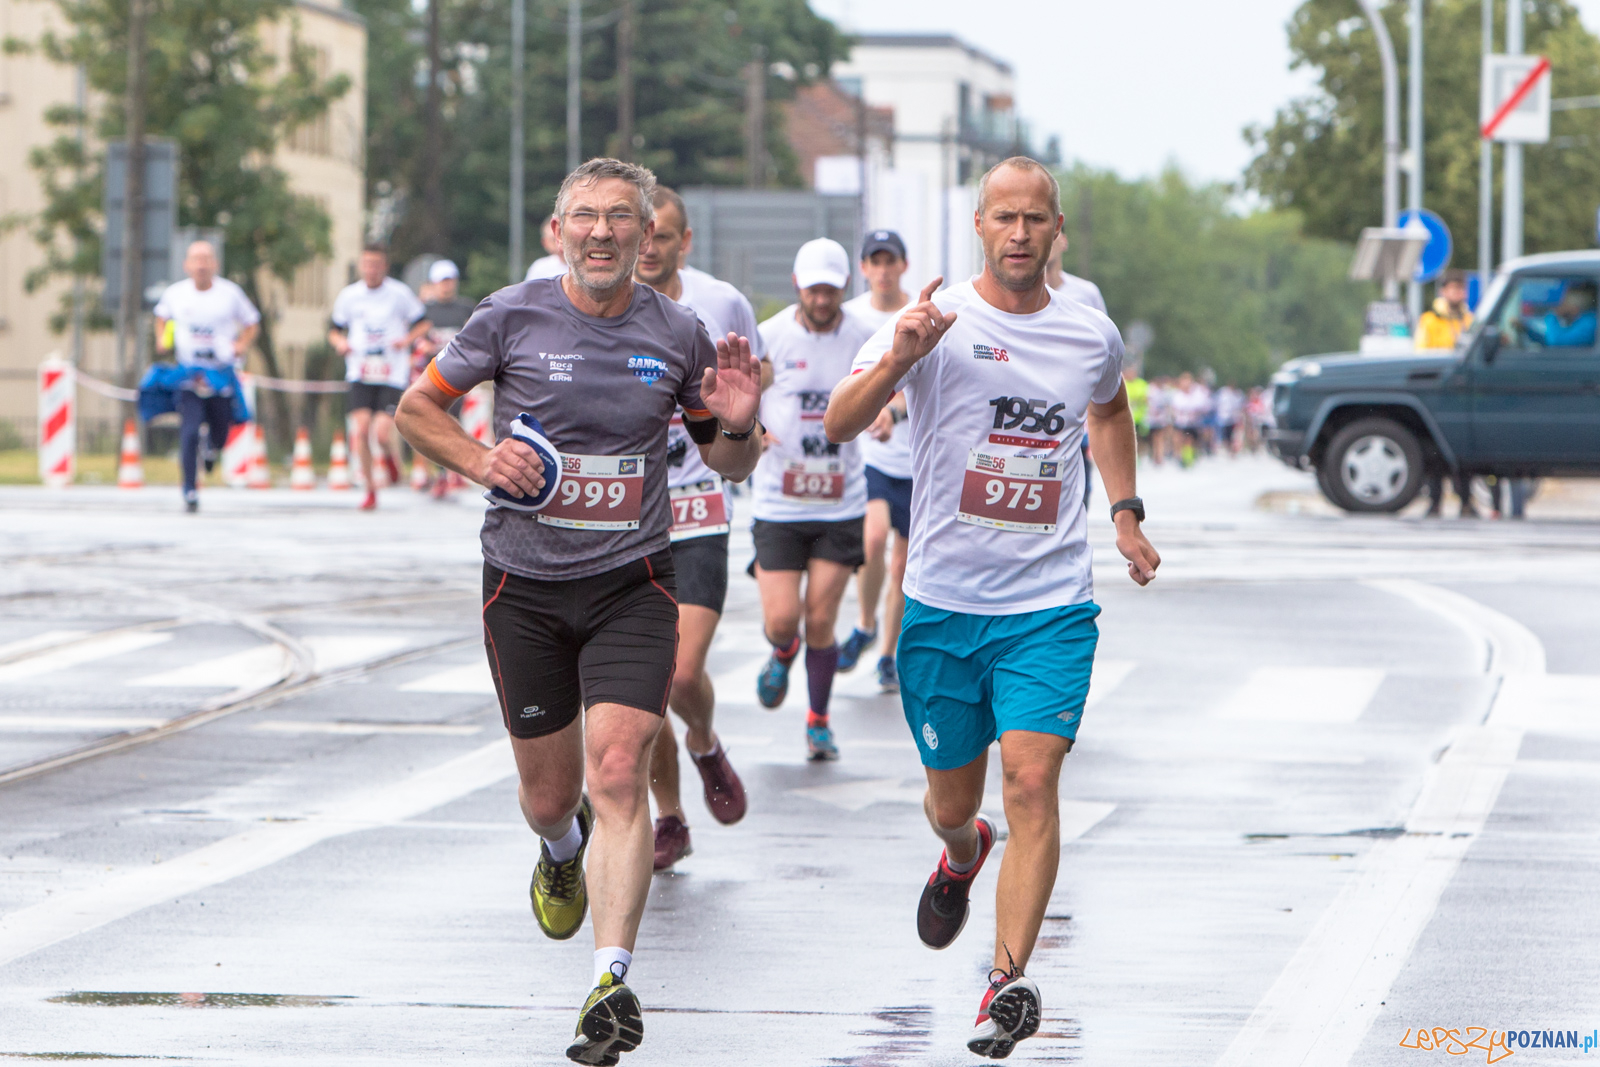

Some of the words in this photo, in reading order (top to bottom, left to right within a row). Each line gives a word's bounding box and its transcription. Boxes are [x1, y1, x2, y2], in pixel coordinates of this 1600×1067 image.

[547, 353, 585, 361] SANPOL
[549, 360, 573, 369] Roca
[549, 373, 573, 382] KERMI
[635, 370, 664, 378] SPORT
[989, 396, 1066, 436] 1956
[792, 475, 833, 495] 502
[560, 479, 626, 509] 999
[985, 479, 1044, 511] 975
